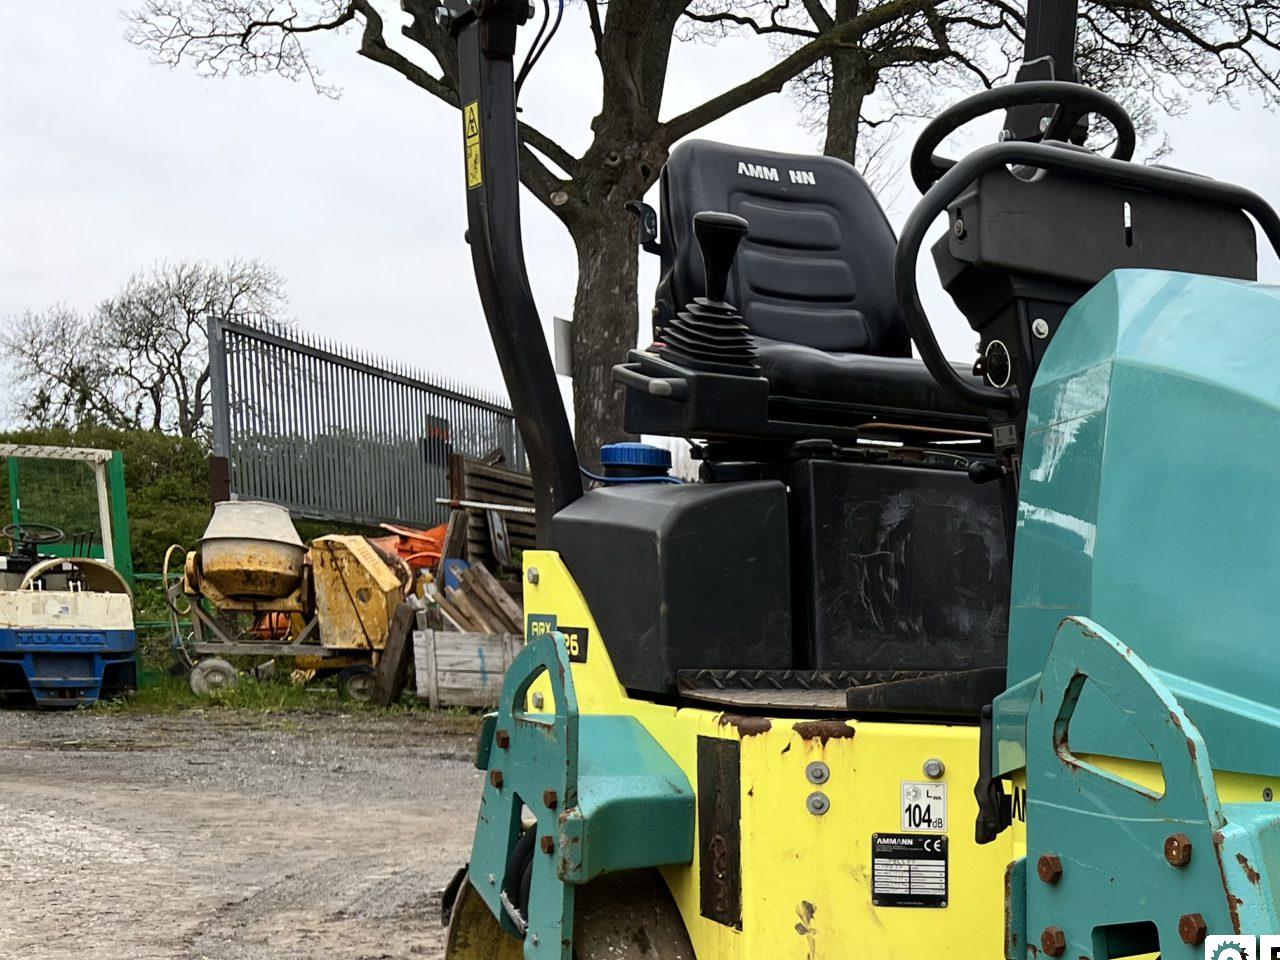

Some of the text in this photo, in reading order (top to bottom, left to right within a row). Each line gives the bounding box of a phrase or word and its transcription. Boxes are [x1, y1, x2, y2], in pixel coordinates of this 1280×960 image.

[17, 631, 105, 646] TOYOTA
[905, 803, 932, 828] 104
[876, 837, 914, 846] AMMANN
